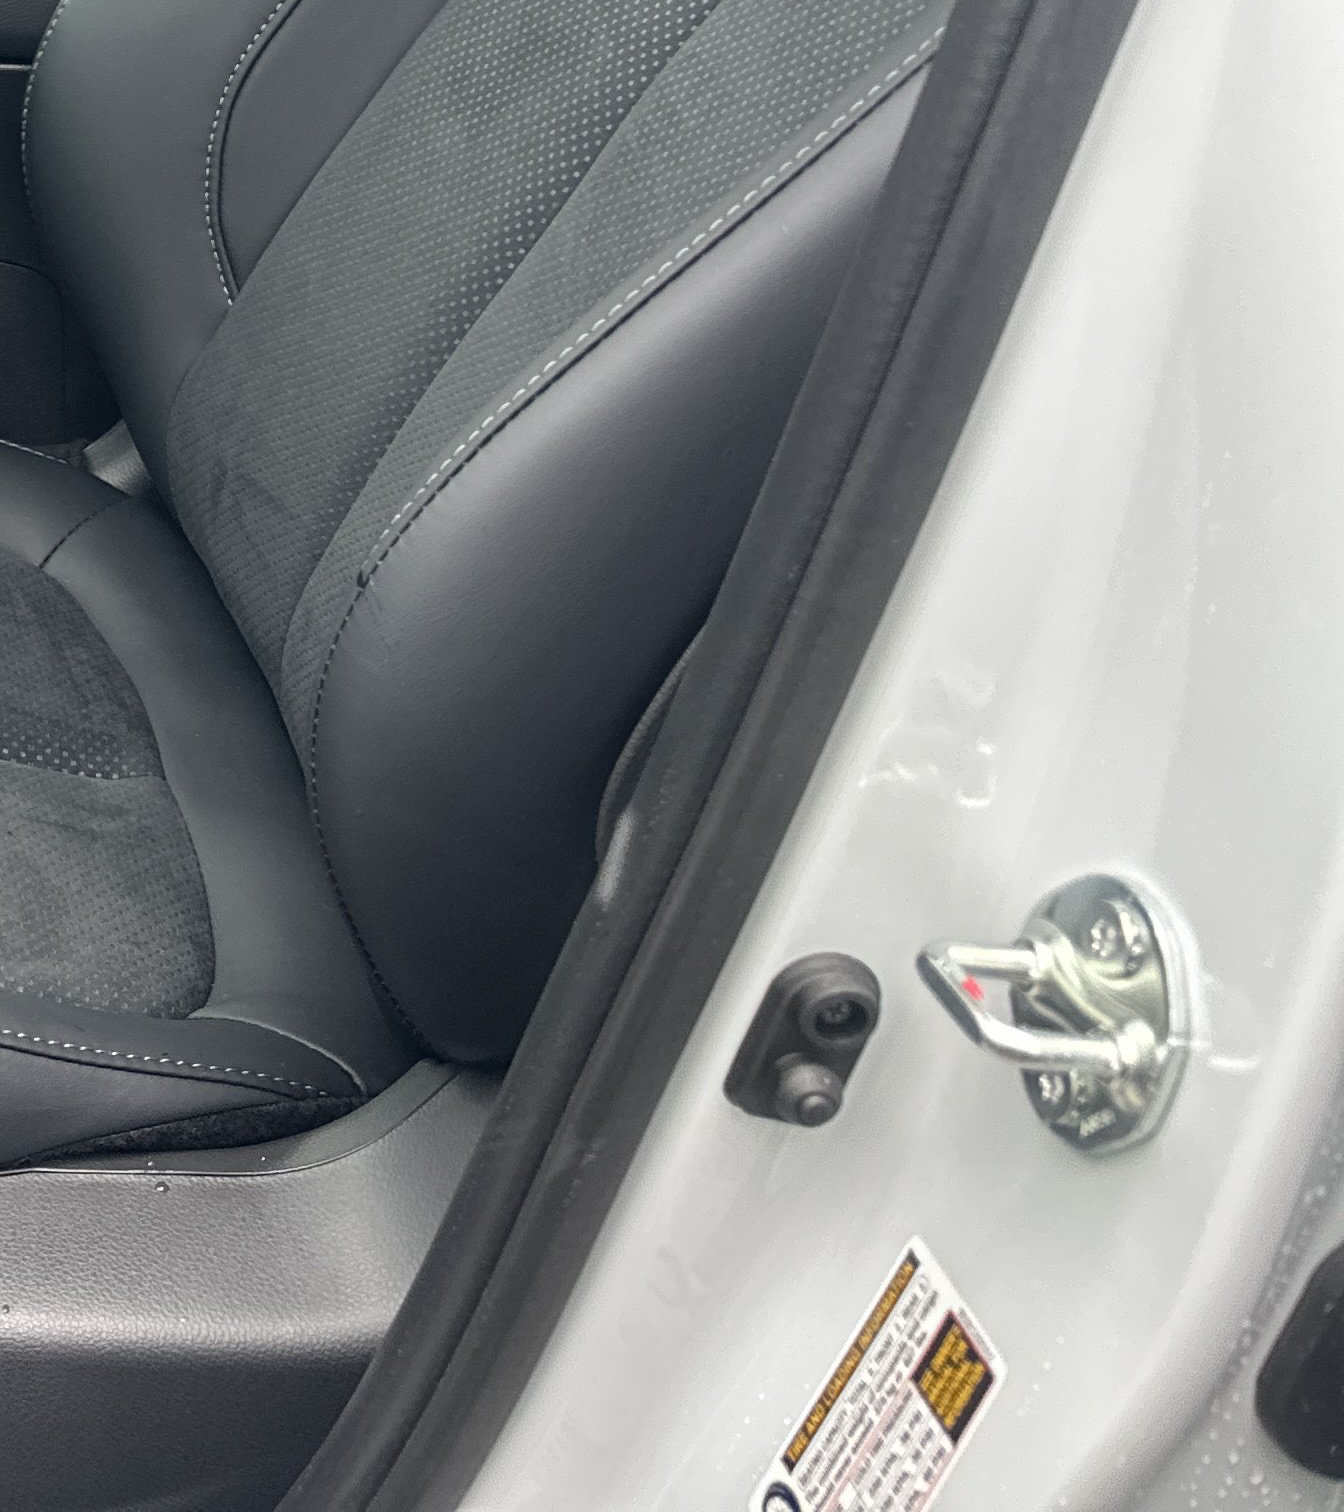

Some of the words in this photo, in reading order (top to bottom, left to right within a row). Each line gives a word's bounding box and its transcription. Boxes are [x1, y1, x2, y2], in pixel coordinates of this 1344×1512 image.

[803, 1400, 826, 1437] AND
[821, 1343, 861, 1408] LOADING
[856, 1257, 914, 1351] INFORMATION
